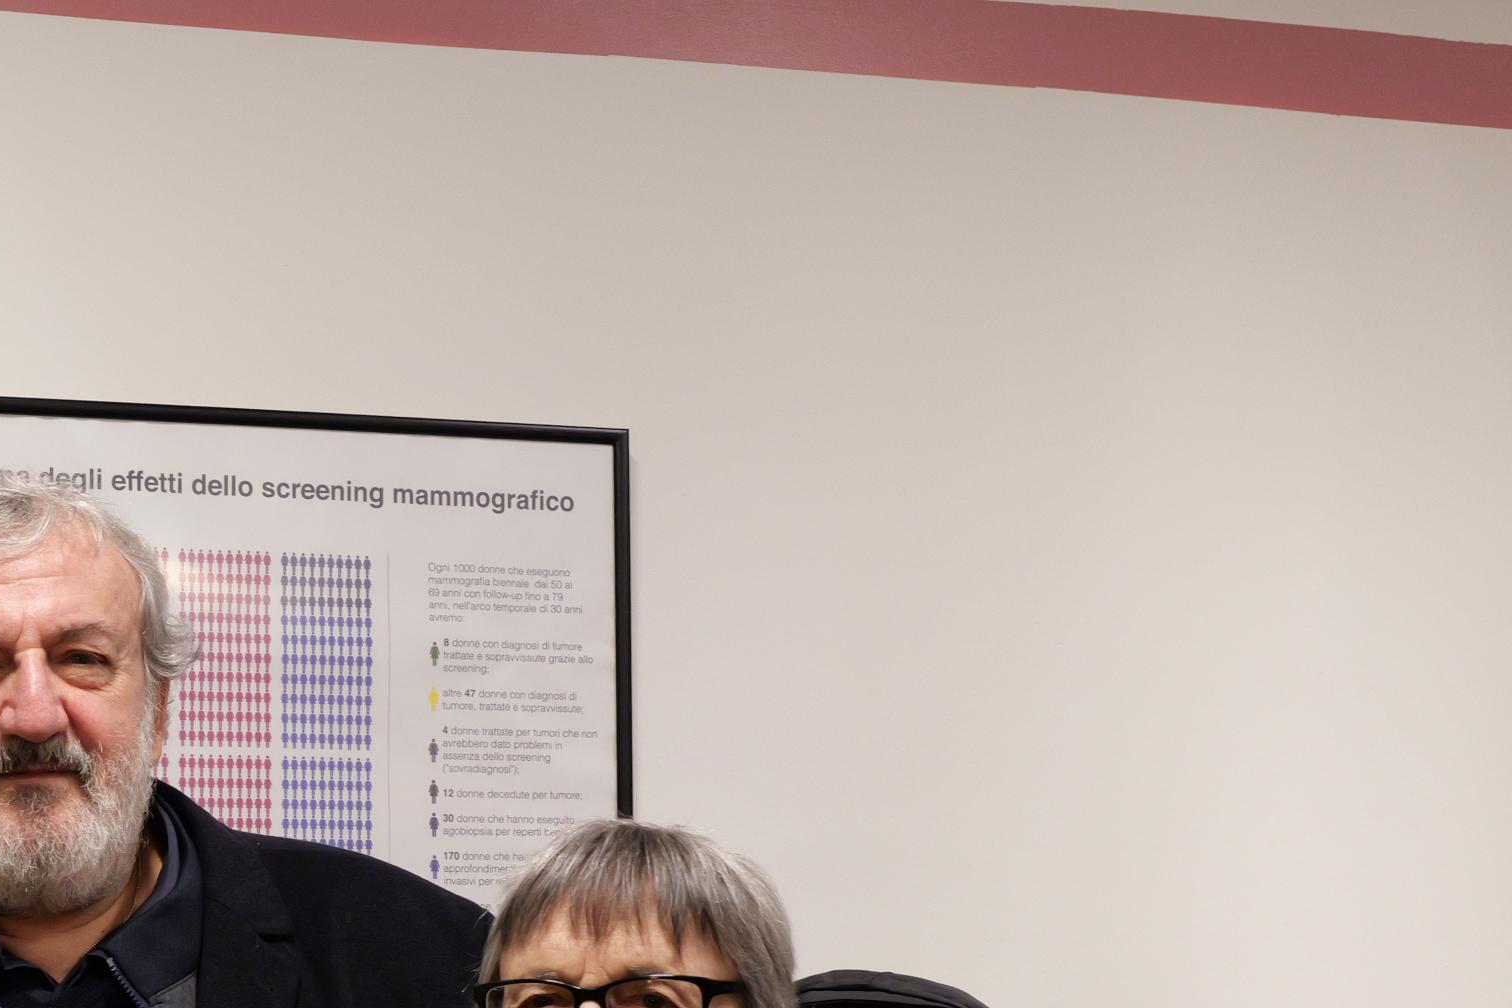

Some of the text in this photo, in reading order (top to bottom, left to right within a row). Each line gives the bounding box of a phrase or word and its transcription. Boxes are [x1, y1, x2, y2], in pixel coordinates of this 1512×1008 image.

[40, 467, 102, 495] degli
[111, 470, 182, 494] effetti
[191, 473, 254, 498] dello
[262, 480, 384, 508] screening
[393, 485, 575, 514] mammografico
[428, 562, 570, 578] Ogni 1000 donne che eseguono
[428, 576, 572, 589] mammografia biennale dai 50 ai
[428, 588, 439, 596] 69
[484, 590, 522, 600] follow-up
[525, 592, 541, 600] fino
[552, 592, 563, 601] 79
[429, 601, 450, 610] anni,
[453, 601, 490, 610] nell'arco
[493, 602, 536, 613] temporale
[551, 605, 561, 613] 30
[429, 614, 464, 622] avremo:
[444, 638, 449, 646] 8
[452, 640, 480, 648] donne
[502, 641, 538, 651] diagnosi
[542, 641, 550, 650] di
[553, 642, 583, 650] tumore
[443, 651, 474, 660] trattate
[486, 654, 545, 662] sopravvissute
[549, 655, 575, 664] grazie
[578, 655, 593, 664] allo
[443, 664, 489, 675] screening;
[443, 689, 462, 697] altre
[479, 690, 507, 698] donne
[528, 691, 567, 702] diagnosi
[569, 692, 576, 701] di
[443, 702, 476, 710] tumore,
[479, 703, 510, 711] trattate
[521, 704, 584, 714] sopravvissute;
[443, 726, 448, 734] 4
[451, 727, 479, 735] donne
[482, 728, 513, 736] trattate
[516, 730, 530, 738] per
[534, 729, 560, 737] tumori
[563, 729, 579, 738] che
[442, 739, 488, 748] avrebbero
[491, 740, 511, 748] dato
[514, 740, 552, 750] problemi
[507, 753, 551, 763] screening
[457, 790, 484, 798] donne
[487, 790, 530, 799] decedute
[532, 792, 547, 800] per
[549, 791, 583, 800] tumore;
[457, 815, 485, 823] donne
[488, 815, 504, 823] che
[537, 816, 575, 826] eseguito
[443, 827, 493, 837] agobiopsia
[495, 828, 510, 837] per
[513, 829, 542, 837] reperti
[444, 852, 459, 860] 170
[494, 853, 510, 861] che
